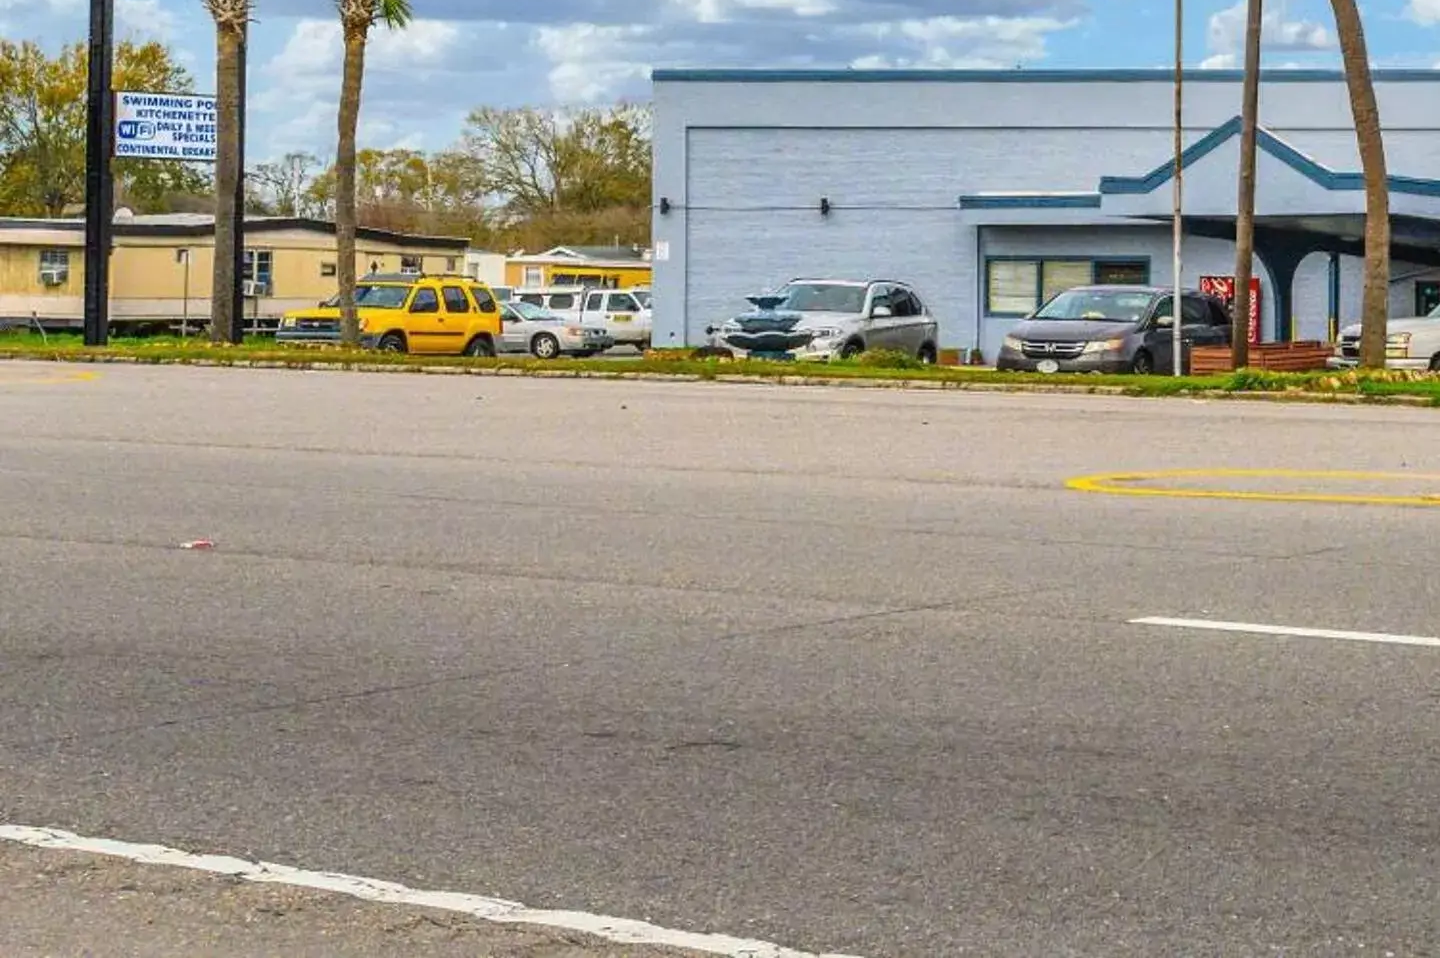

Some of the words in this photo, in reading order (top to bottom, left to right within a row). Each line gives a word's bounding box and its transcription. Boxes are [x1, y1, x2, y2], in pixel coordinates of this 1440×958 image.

[123, 95, 193, 108] SWIMMING
[157, 122, 183, 131] DAILY
[172, 132, 216, 142] SPECIALS
[117, 144, 180, 155] CONTINENTAL
